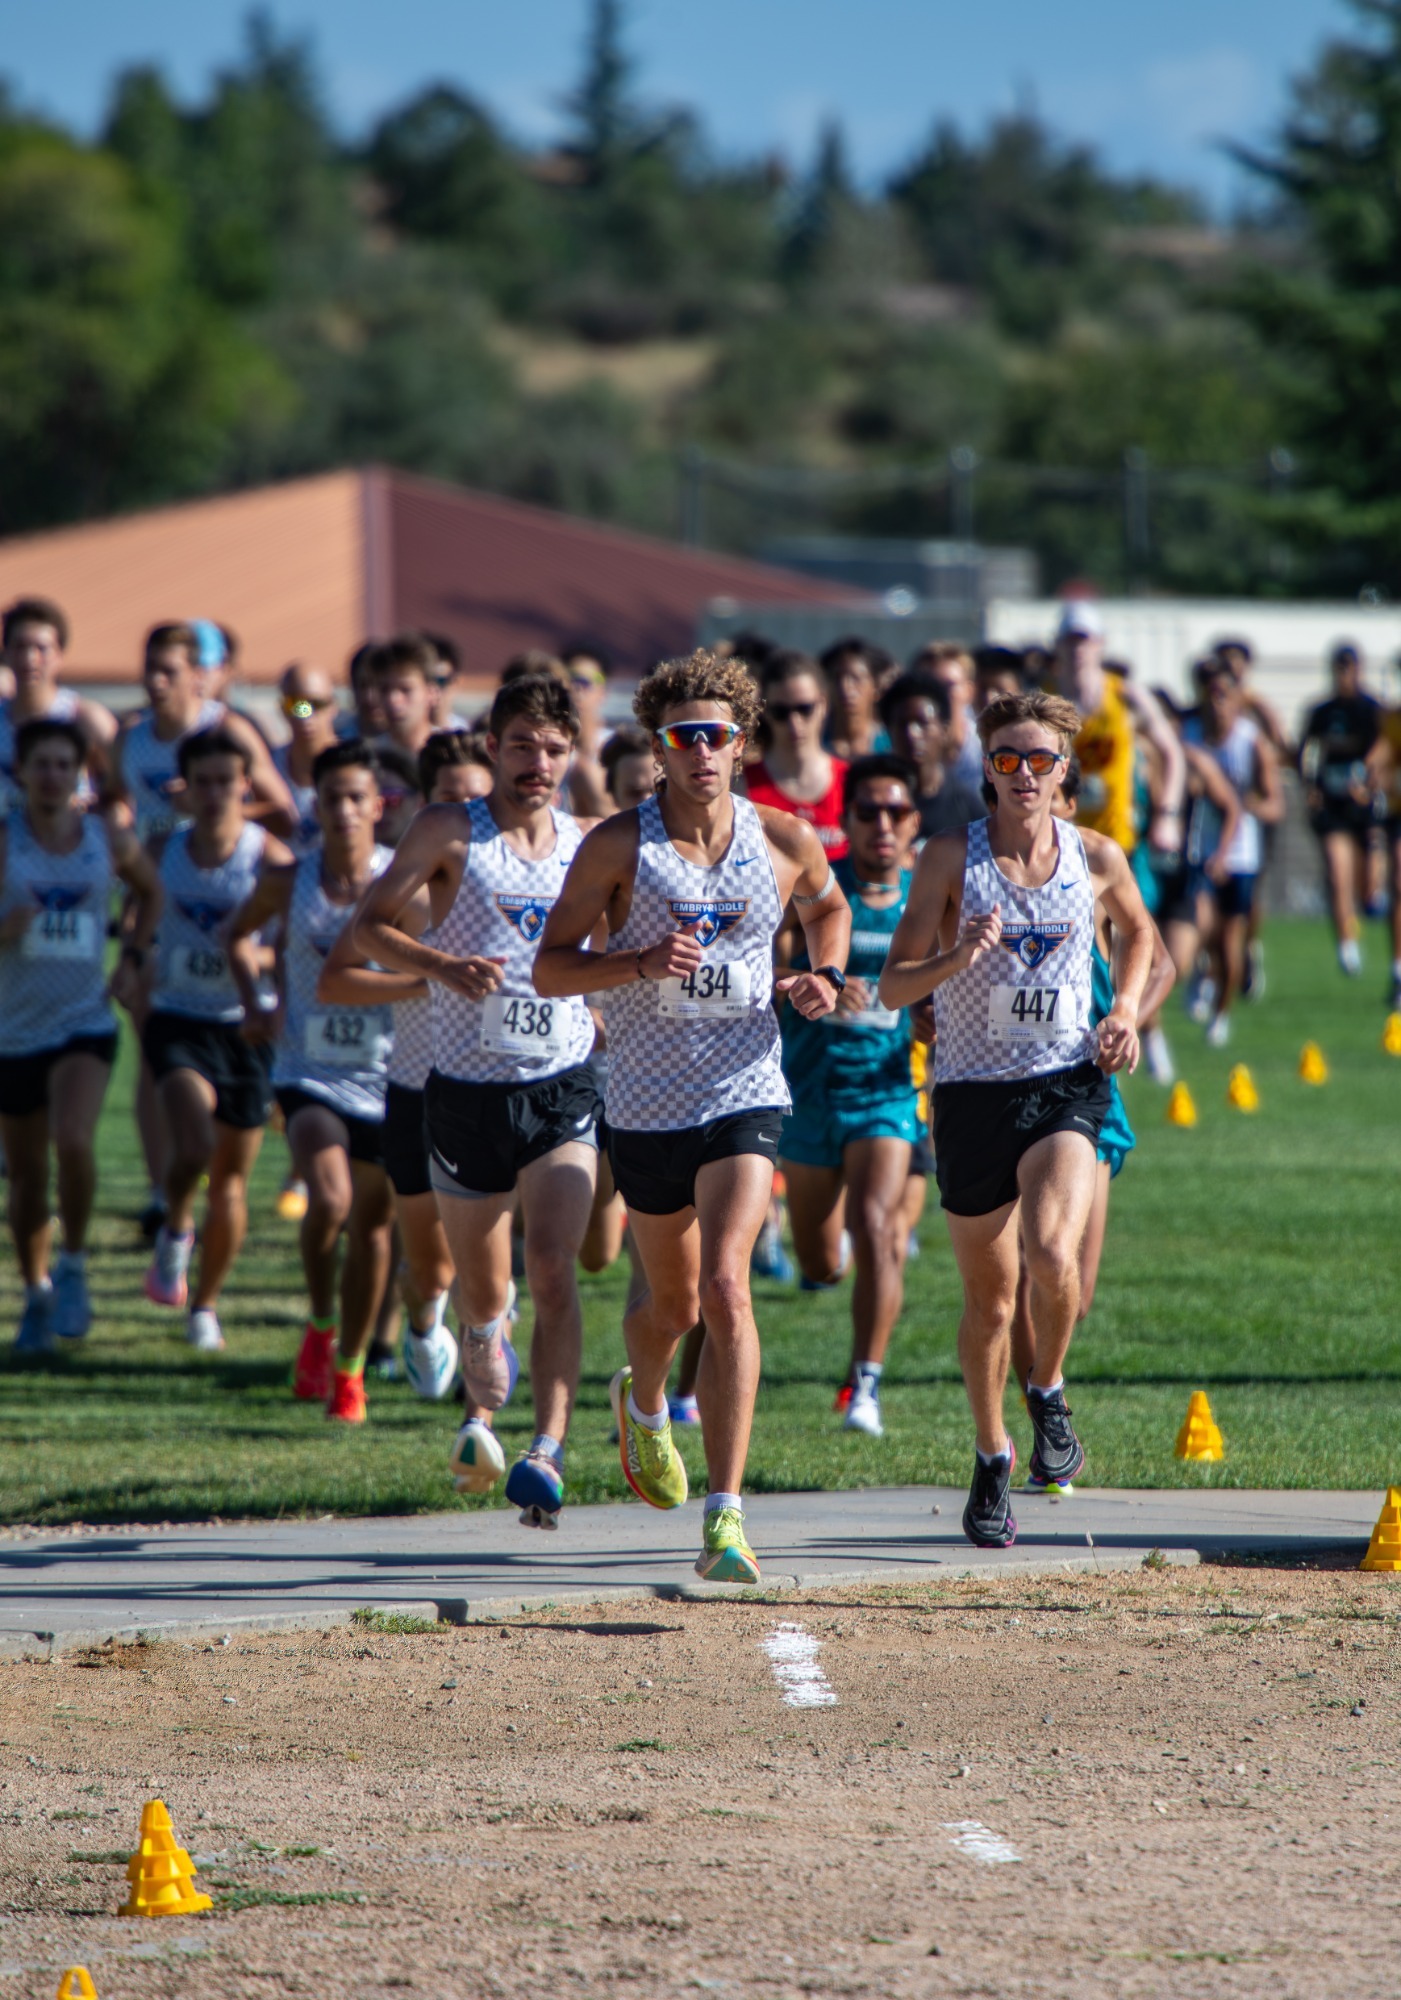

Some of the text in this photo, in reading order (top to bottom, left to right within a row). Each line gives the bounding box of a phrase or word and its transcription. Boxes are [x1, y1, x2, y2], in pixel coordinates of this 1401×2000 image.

[499, 894, 557, 907] EMBRY-RID
[673, 901, 745, 912] EMBRY-RIDDLE
[1002, 923, 1069, 935] MBRY-RIDDLE
[681, 964, 732, 998] 434
[503, 1000, 553, 1037] 438
[1010, 988, 1060, 1023] 447
[323, 1015, 365, 1048] 432
